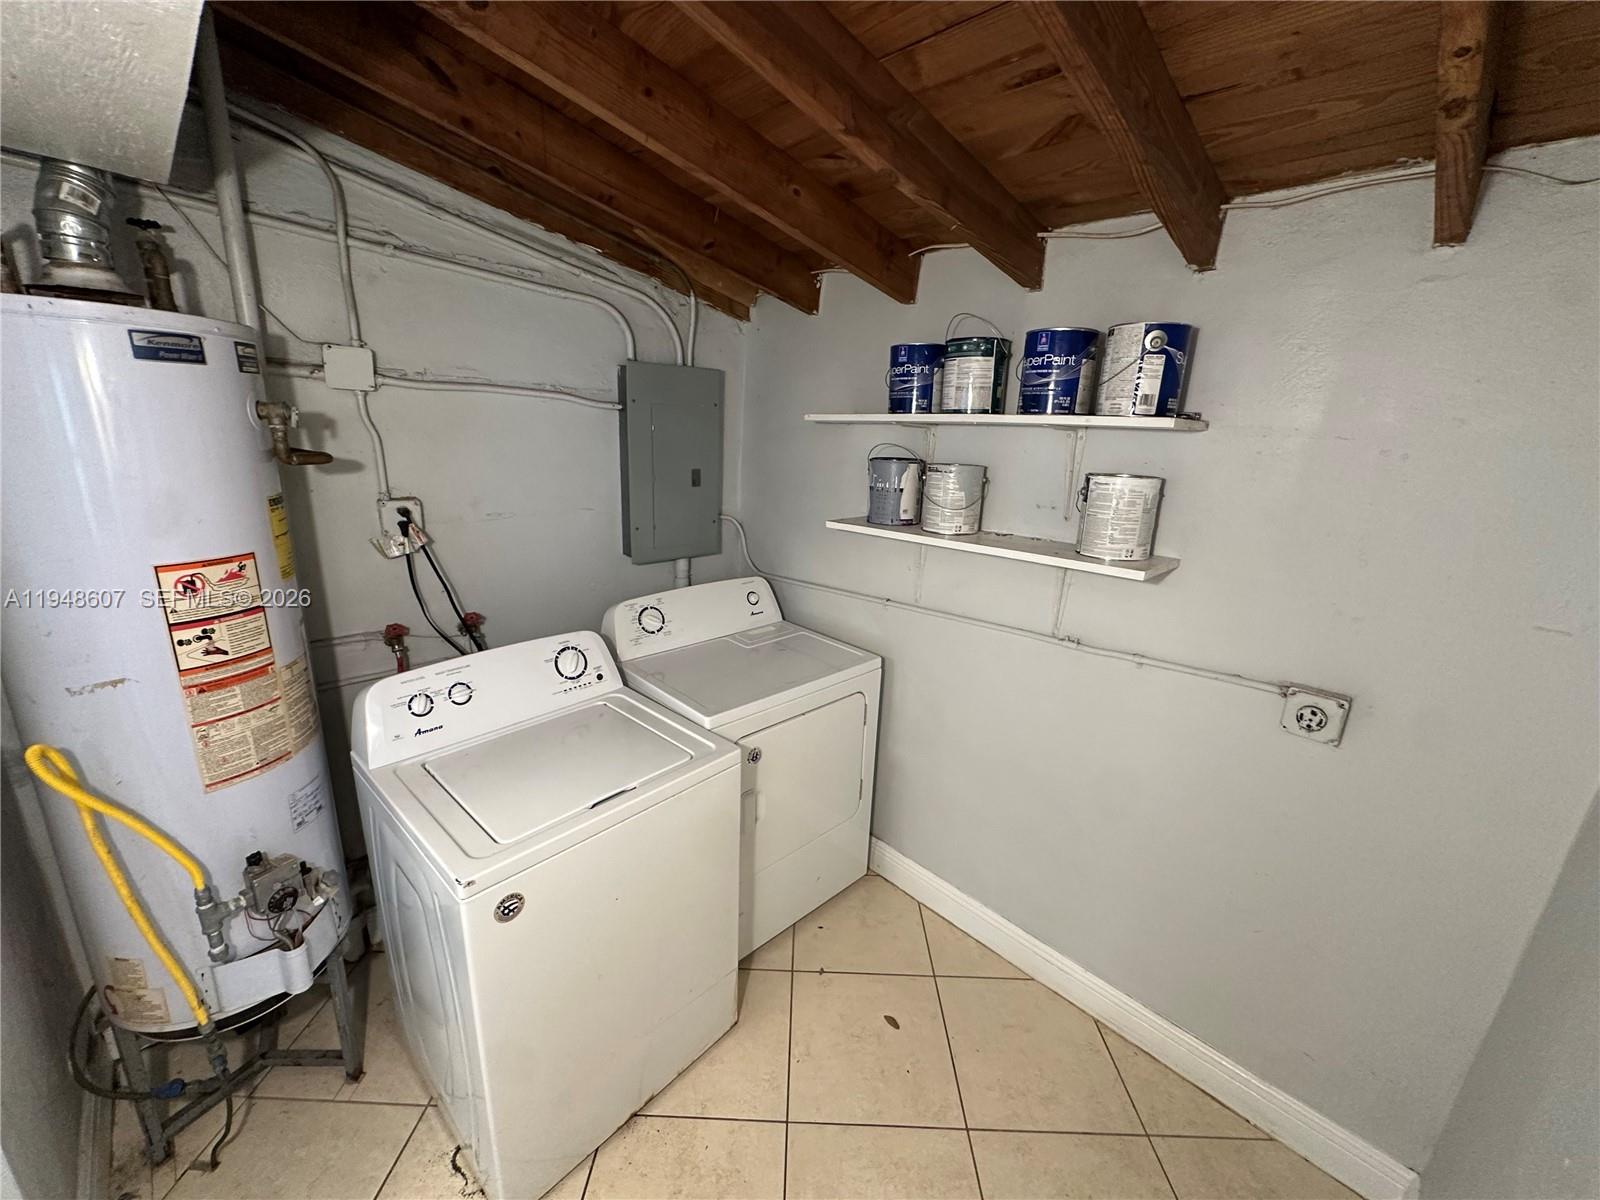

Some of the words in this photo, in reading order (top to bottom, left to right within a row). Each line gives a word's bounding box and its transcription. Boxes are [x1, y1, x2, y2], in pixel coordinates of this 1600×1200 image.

[147, 339, 200, 351] Kenmore
[891, 363, 929, 376] perPaint
[414, 724, 444, 737] Amana
